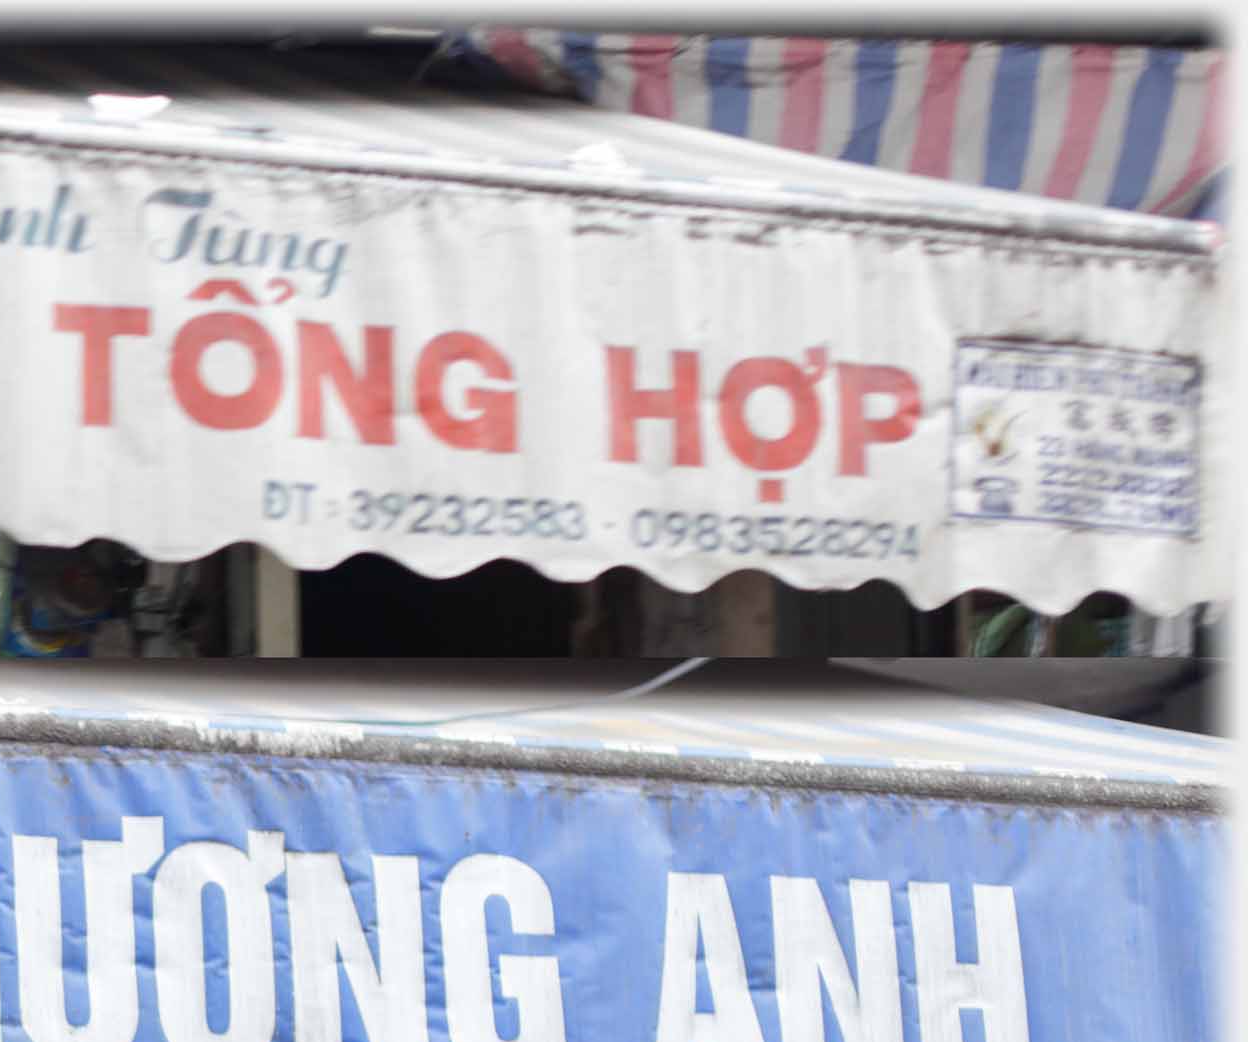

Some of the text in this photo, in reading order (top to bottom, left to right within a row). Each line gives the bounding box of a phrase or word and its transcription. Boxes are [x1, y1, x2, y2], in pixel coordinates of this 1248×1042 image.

[51, 279, 520, 455] TỔNG
[602, 345, 923, 503] HỢP
[348, 489, 590, 541] 39232583
[628, 507, 920, 562] 0983528294
